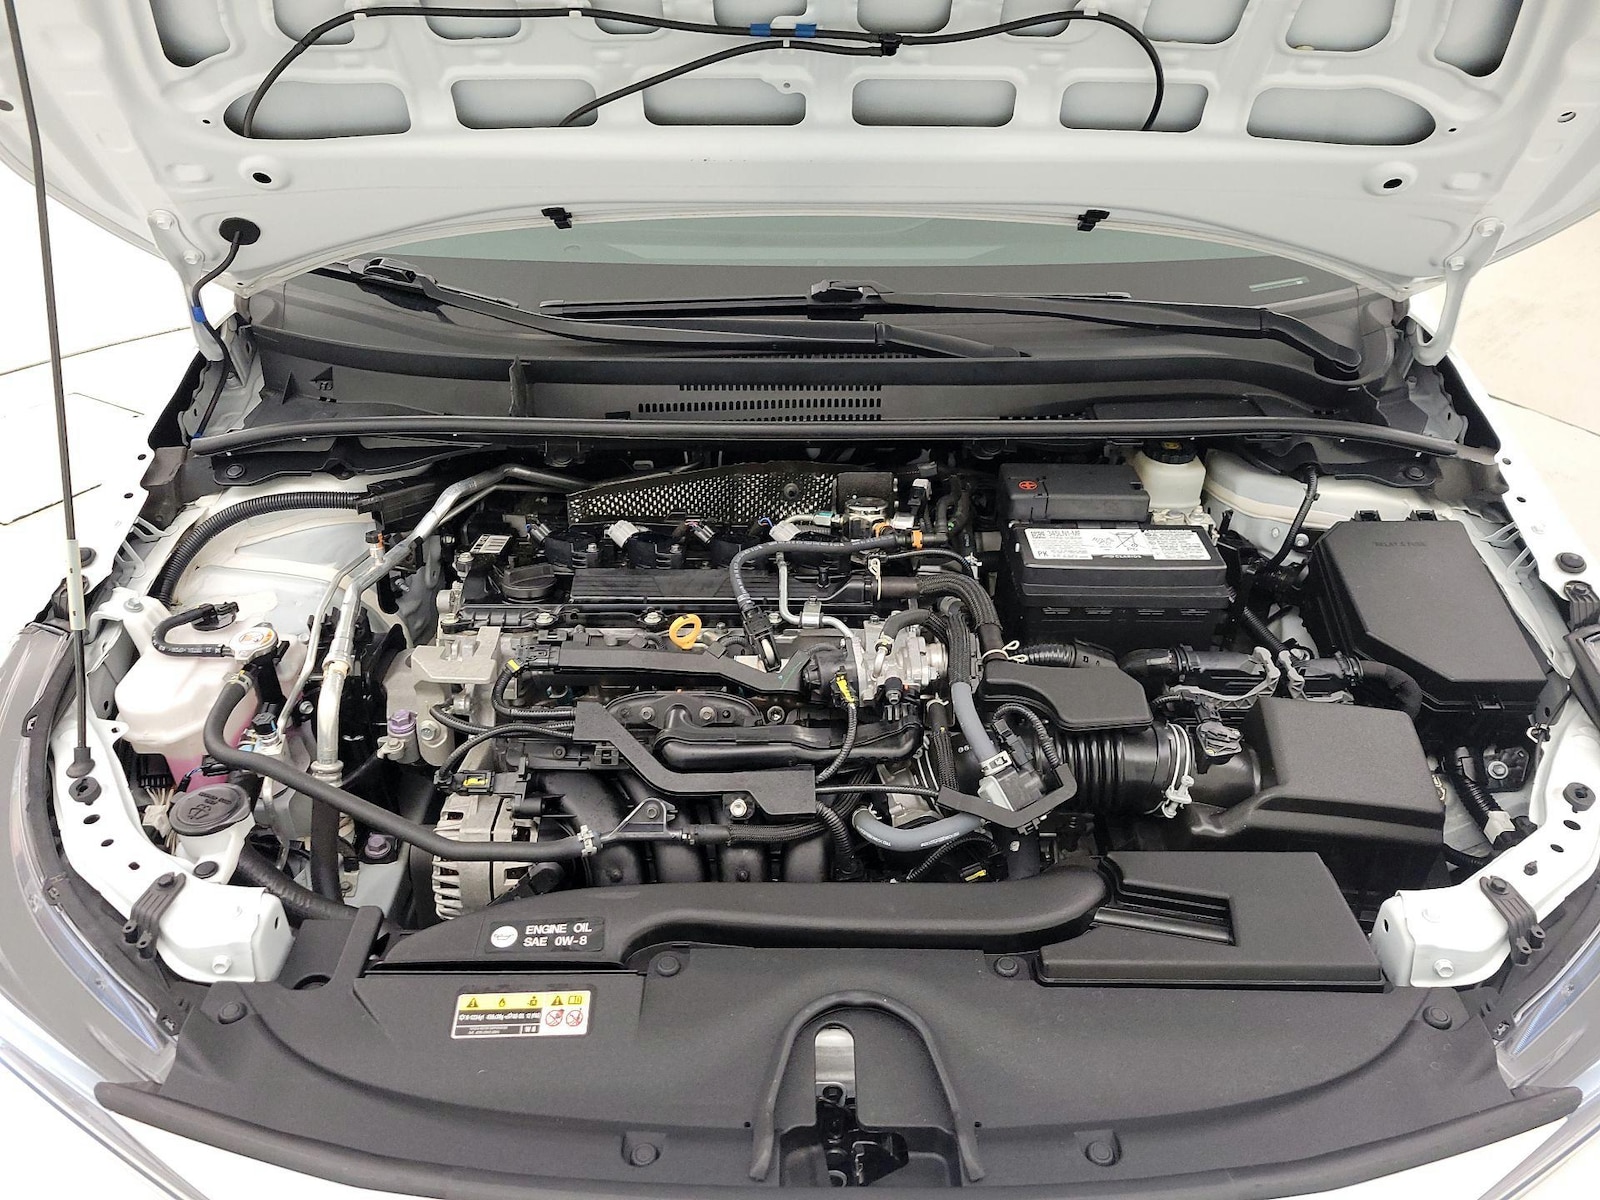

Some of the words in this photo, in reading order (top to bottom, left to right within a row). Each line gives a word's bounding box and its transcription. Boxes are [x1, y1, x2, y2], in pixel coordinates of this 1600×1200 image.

[525, 923, 567, 934] ENGINE
[573, 922, 592, 933] OIL
[523, 936, 548, 947] SAE
[554, 935, 588, 946] 0W-8
